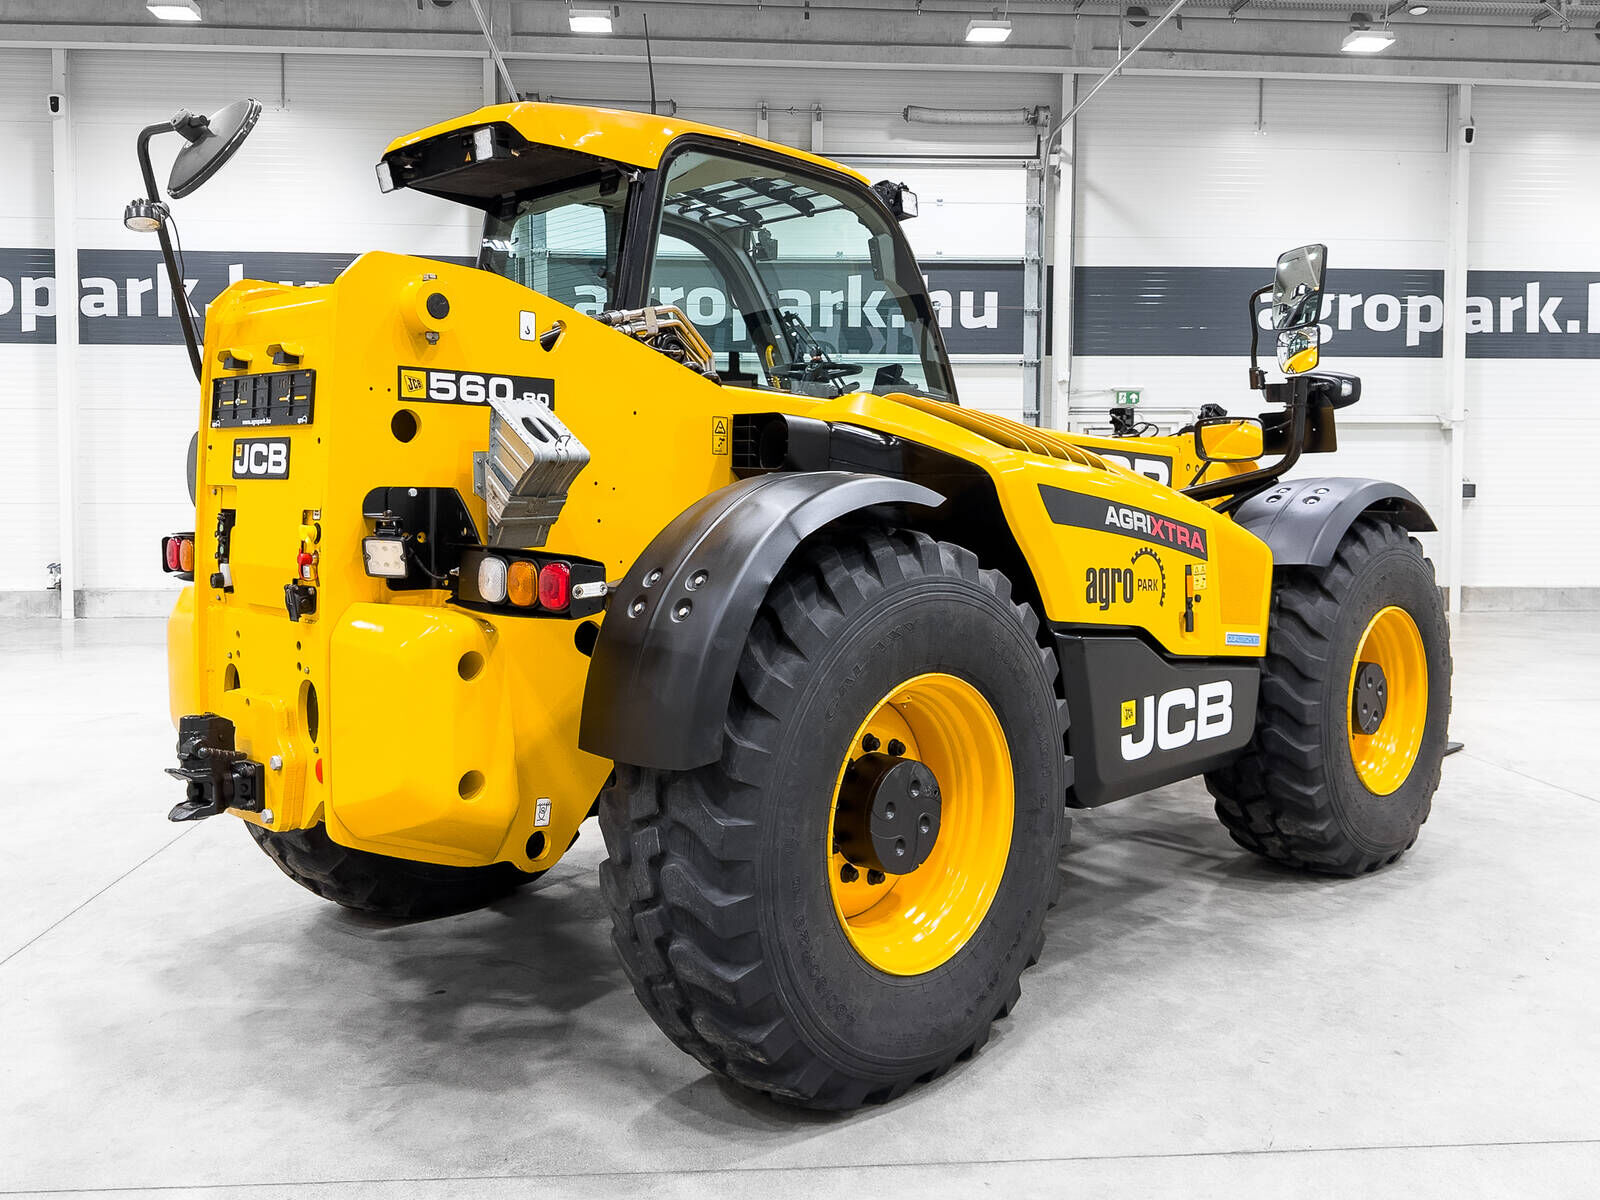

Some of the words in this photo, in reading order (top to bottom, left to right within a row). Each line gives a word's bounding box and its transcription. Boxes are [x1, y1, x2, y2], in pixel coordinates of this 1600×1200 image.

[233, 443, 288, 475] JCB
[1104, 505, 1205, 553] AGRIXTRA
[1085, 567, 1134, 611] agro
[1137, 578, 1159, 592] PARK
[1120, 680, 1233, 761] JCB
